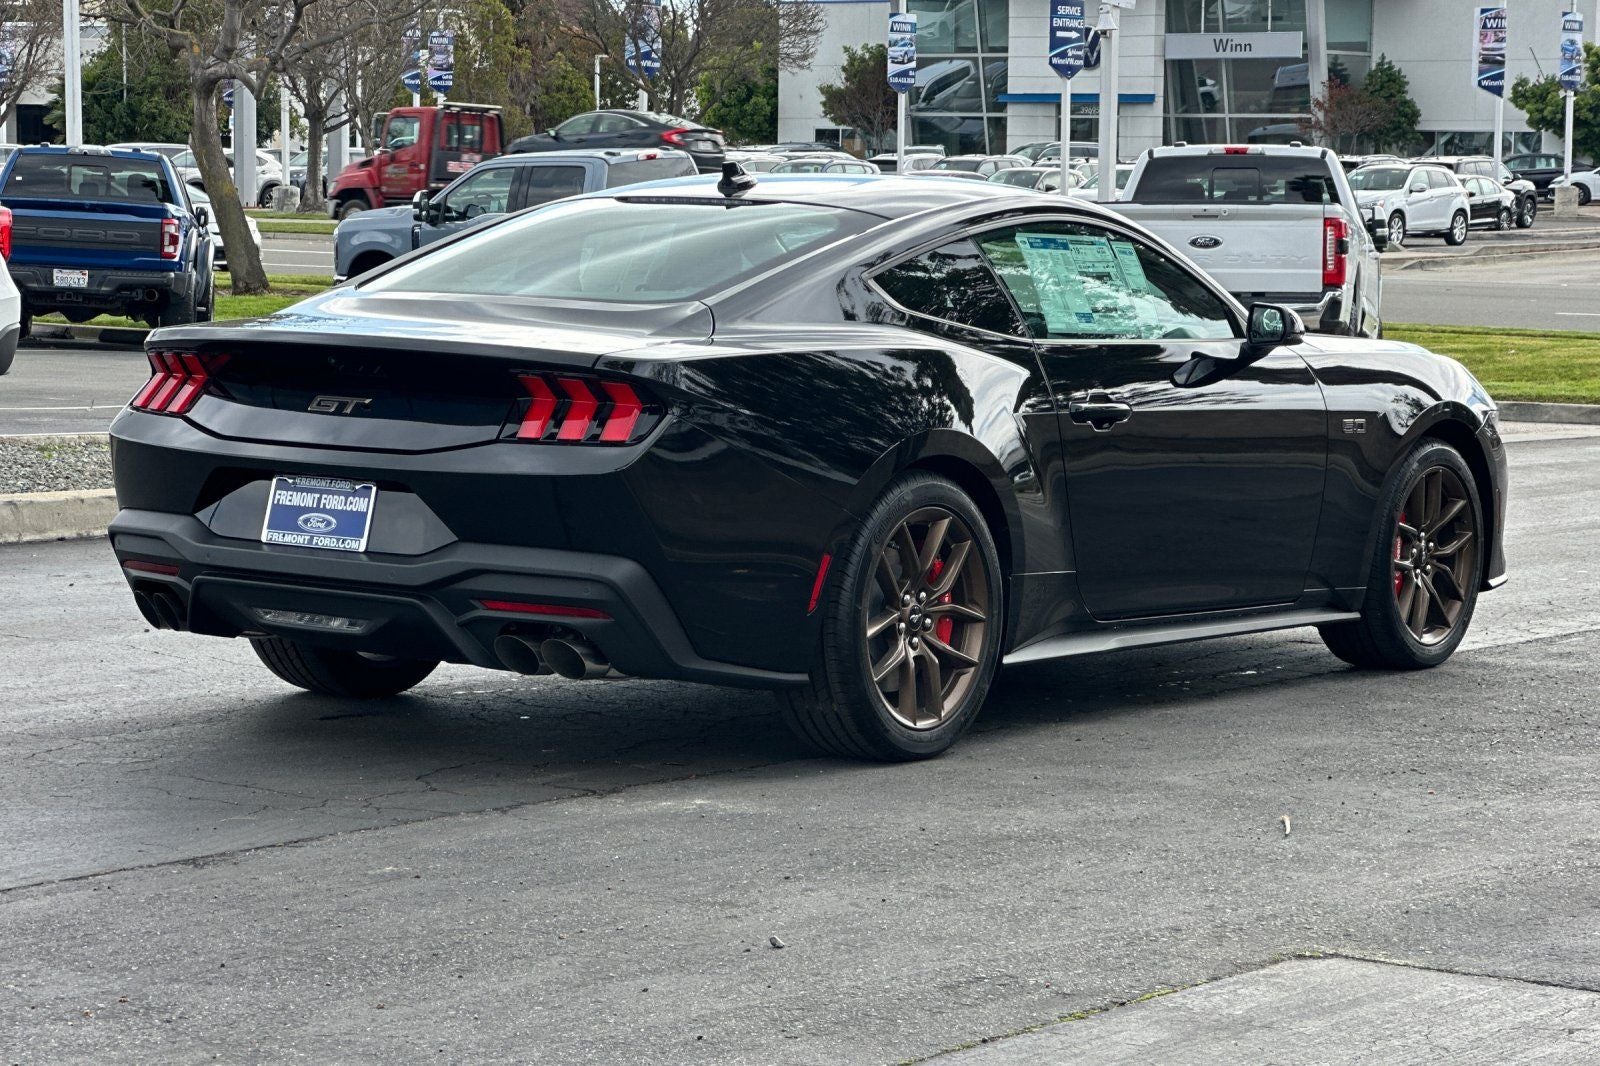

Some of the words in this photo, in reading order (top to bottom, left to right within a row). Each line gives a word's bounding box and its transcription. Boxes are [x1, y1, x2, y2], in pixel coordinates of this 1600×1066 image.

[1057, 6, 1081, 15] SERVICE
[892, 22, 911, 32] WINN
[1053, 18, 1083, 28] ENTRANCE
[1213, 38, 1252, 52] Winn
[12, 226, 140, 241] FORD
[308, 395, 373, 414] GT
[297, 477, 330, 488] FREMONT
[331, 480, 351, 489] FORD
[274, 490, 320, 508] FREMONT
[320, 494, 369, 512] FORD.COM
[267, 531, 310, 545] FREMONT
[312, 536, 360, 549] FORD.COM
